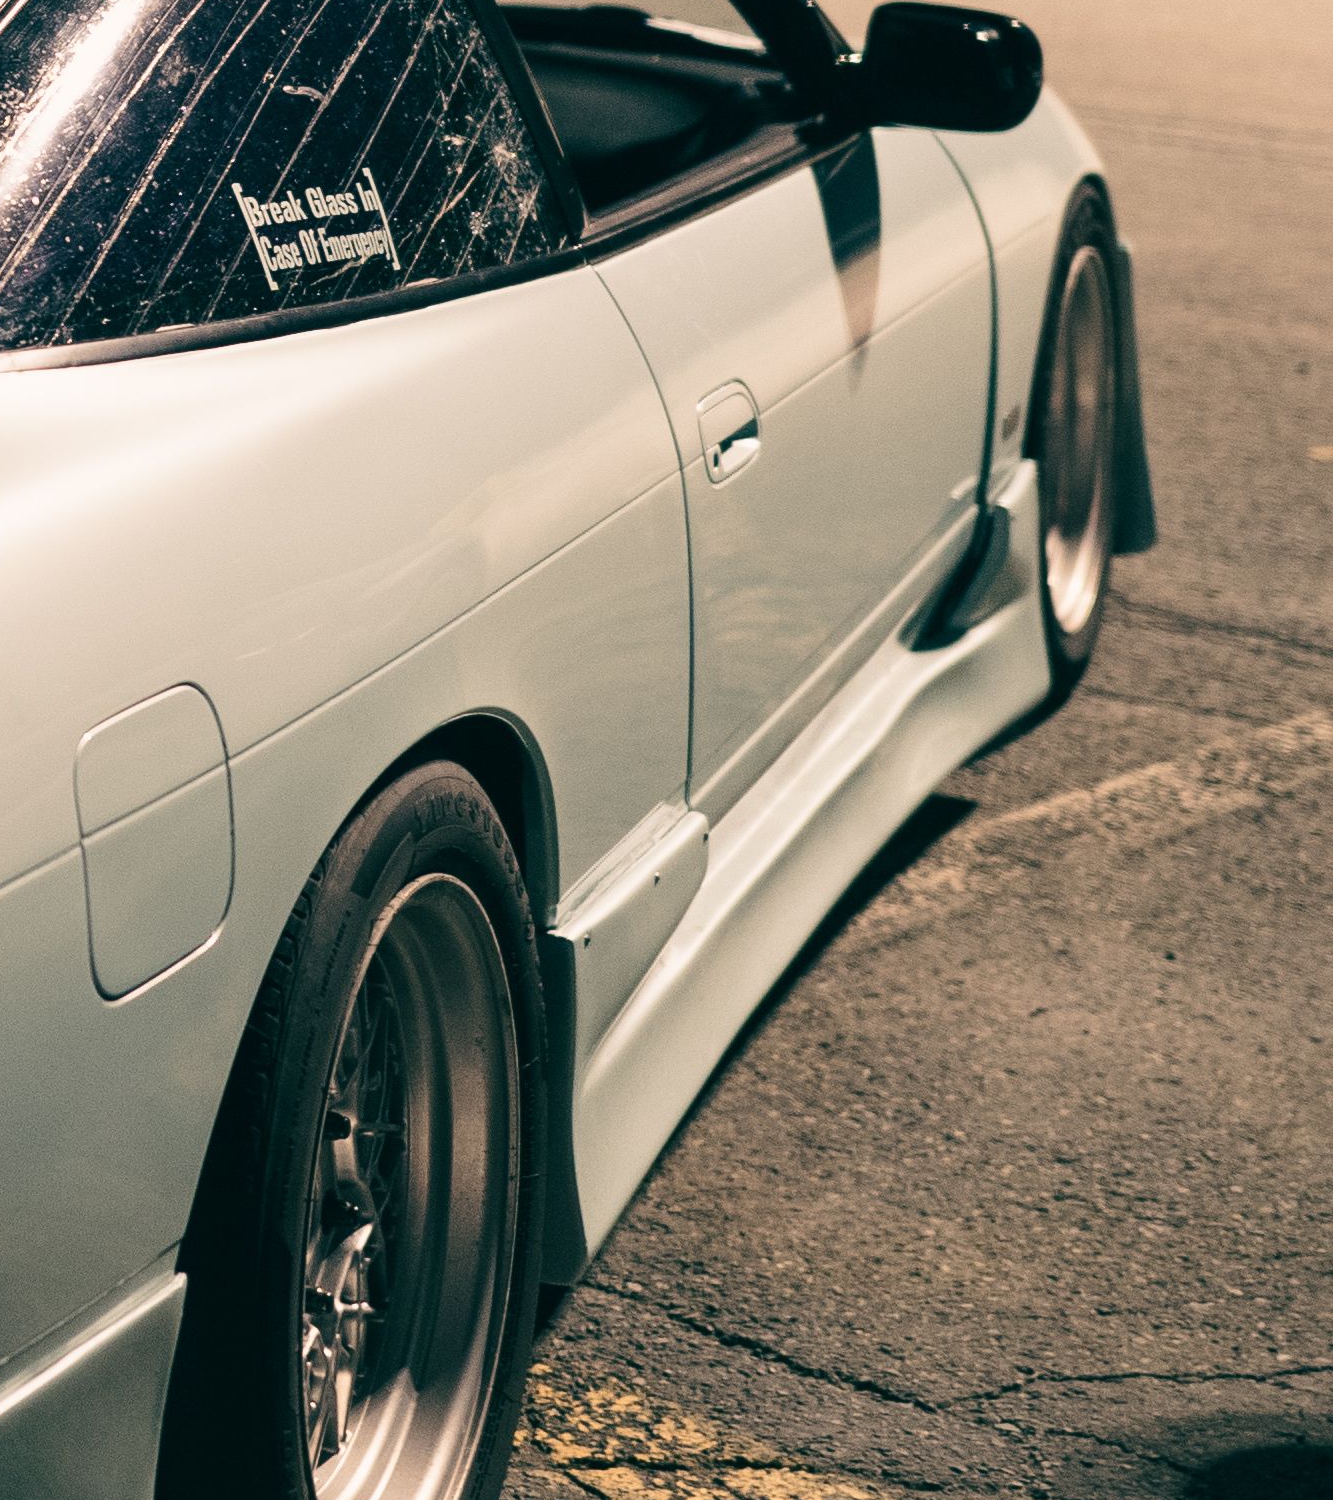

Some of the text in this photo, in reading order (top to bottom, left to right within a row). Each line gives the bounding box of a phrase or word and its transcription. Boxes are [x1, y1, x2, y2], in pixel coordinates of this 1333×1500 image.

[243, 182, 379, 227] Break Glass In
[259, 227, 391, 272] Case Of Emergency
